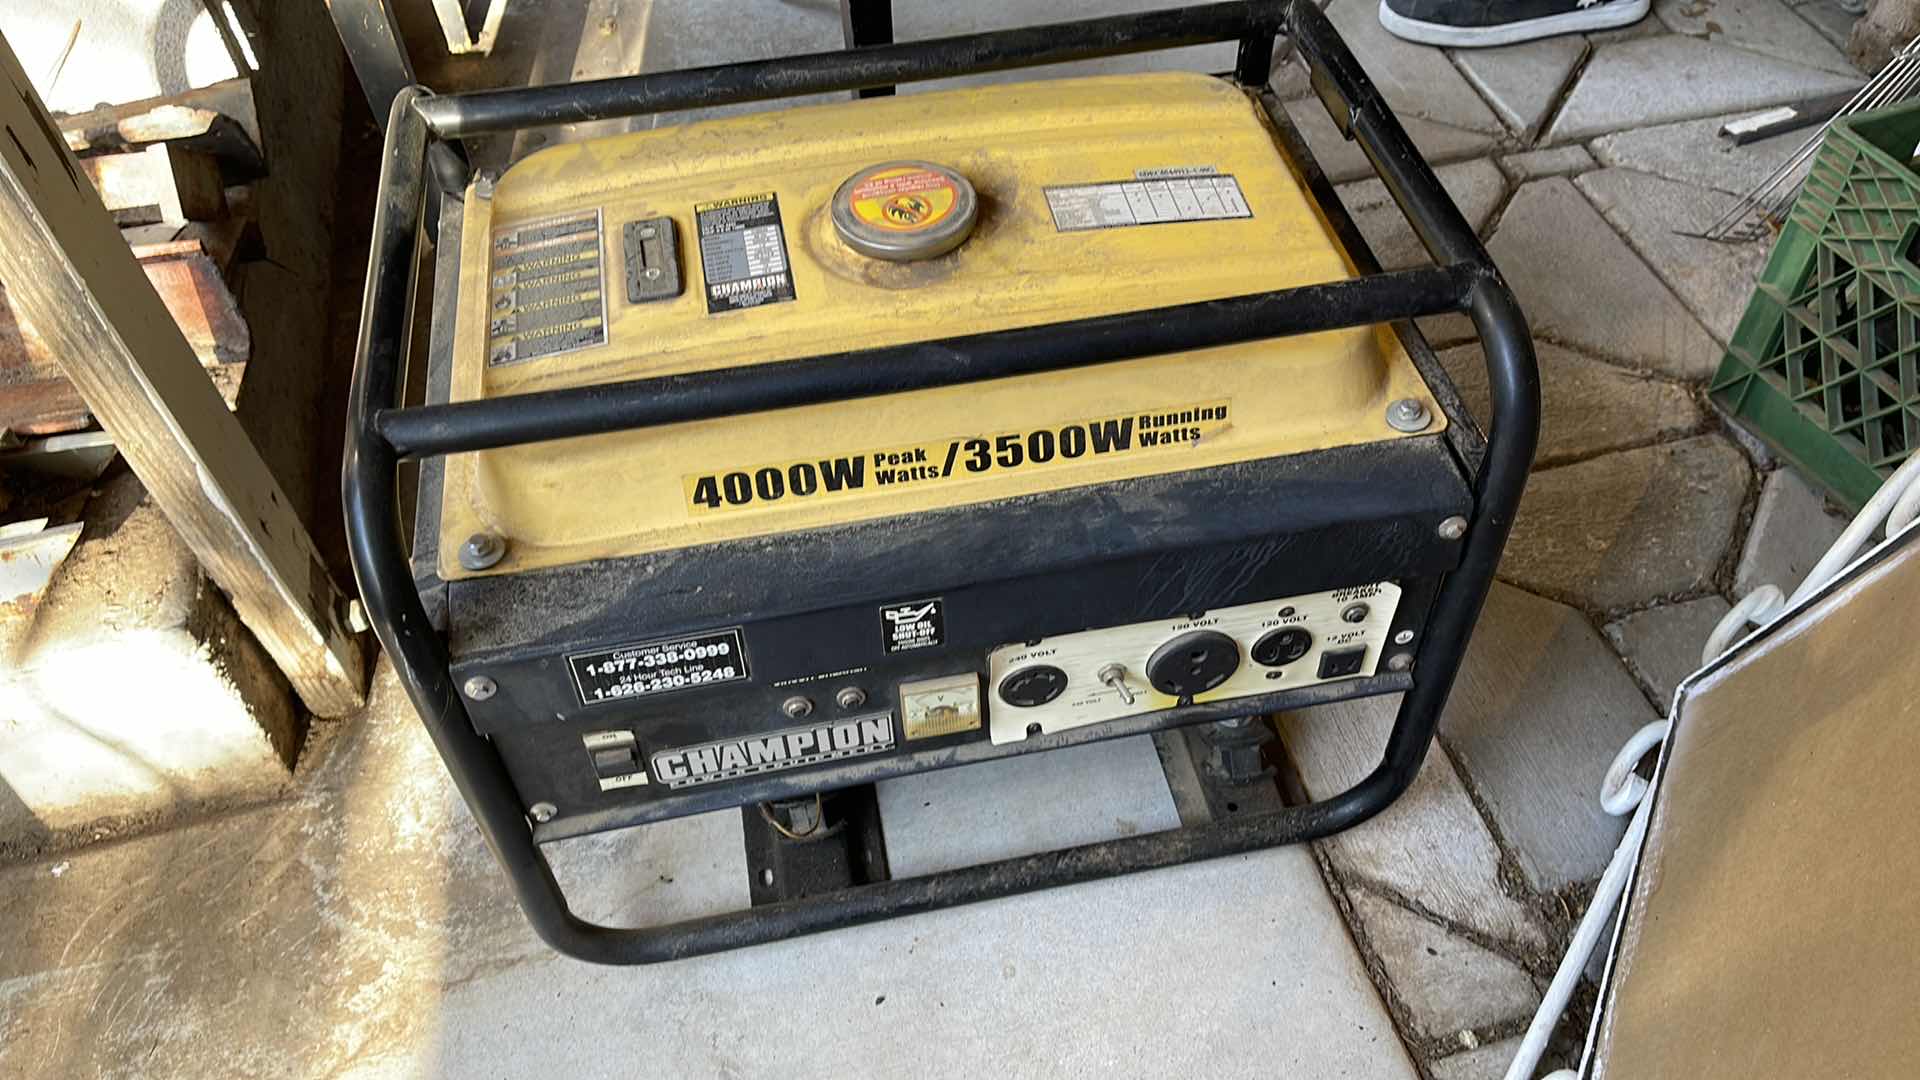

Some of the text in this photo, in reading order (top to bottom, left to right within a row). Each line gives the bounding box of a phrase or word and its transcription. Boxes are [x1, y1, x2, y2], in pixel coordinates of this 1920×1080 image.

[710, 273, 786, 298] CHAMPION
[1138, 405, 1228, 430] Running
[1138, 427, 1201, 449] Watts
[873, 448, 927, 467] Peak
[693, 455, 865, 508] 4000W
[874, 465, 939, 485] Watts
[894, 620, 932, 634] LOW OIL
[1171, 617, 1220, 631] 120 VOLT
[1261, 614, 1309, 629] 120 VOLT
[892, 627, 936, 641] SHUT-OFF
[1341, 630, 1365, 640] VOLT
[586, 642, 730, 677] 1-877-338-0999
[612, 640, 698, 661] Customer Service
[1008, 648, 1057, 664] 240 VOLT
[594, 665, 736, 700] 1-626-230-5248
[619, 663, 704, 684] 24 Hour Tech Line
[656, 717, 891, 782] CHAMPION
